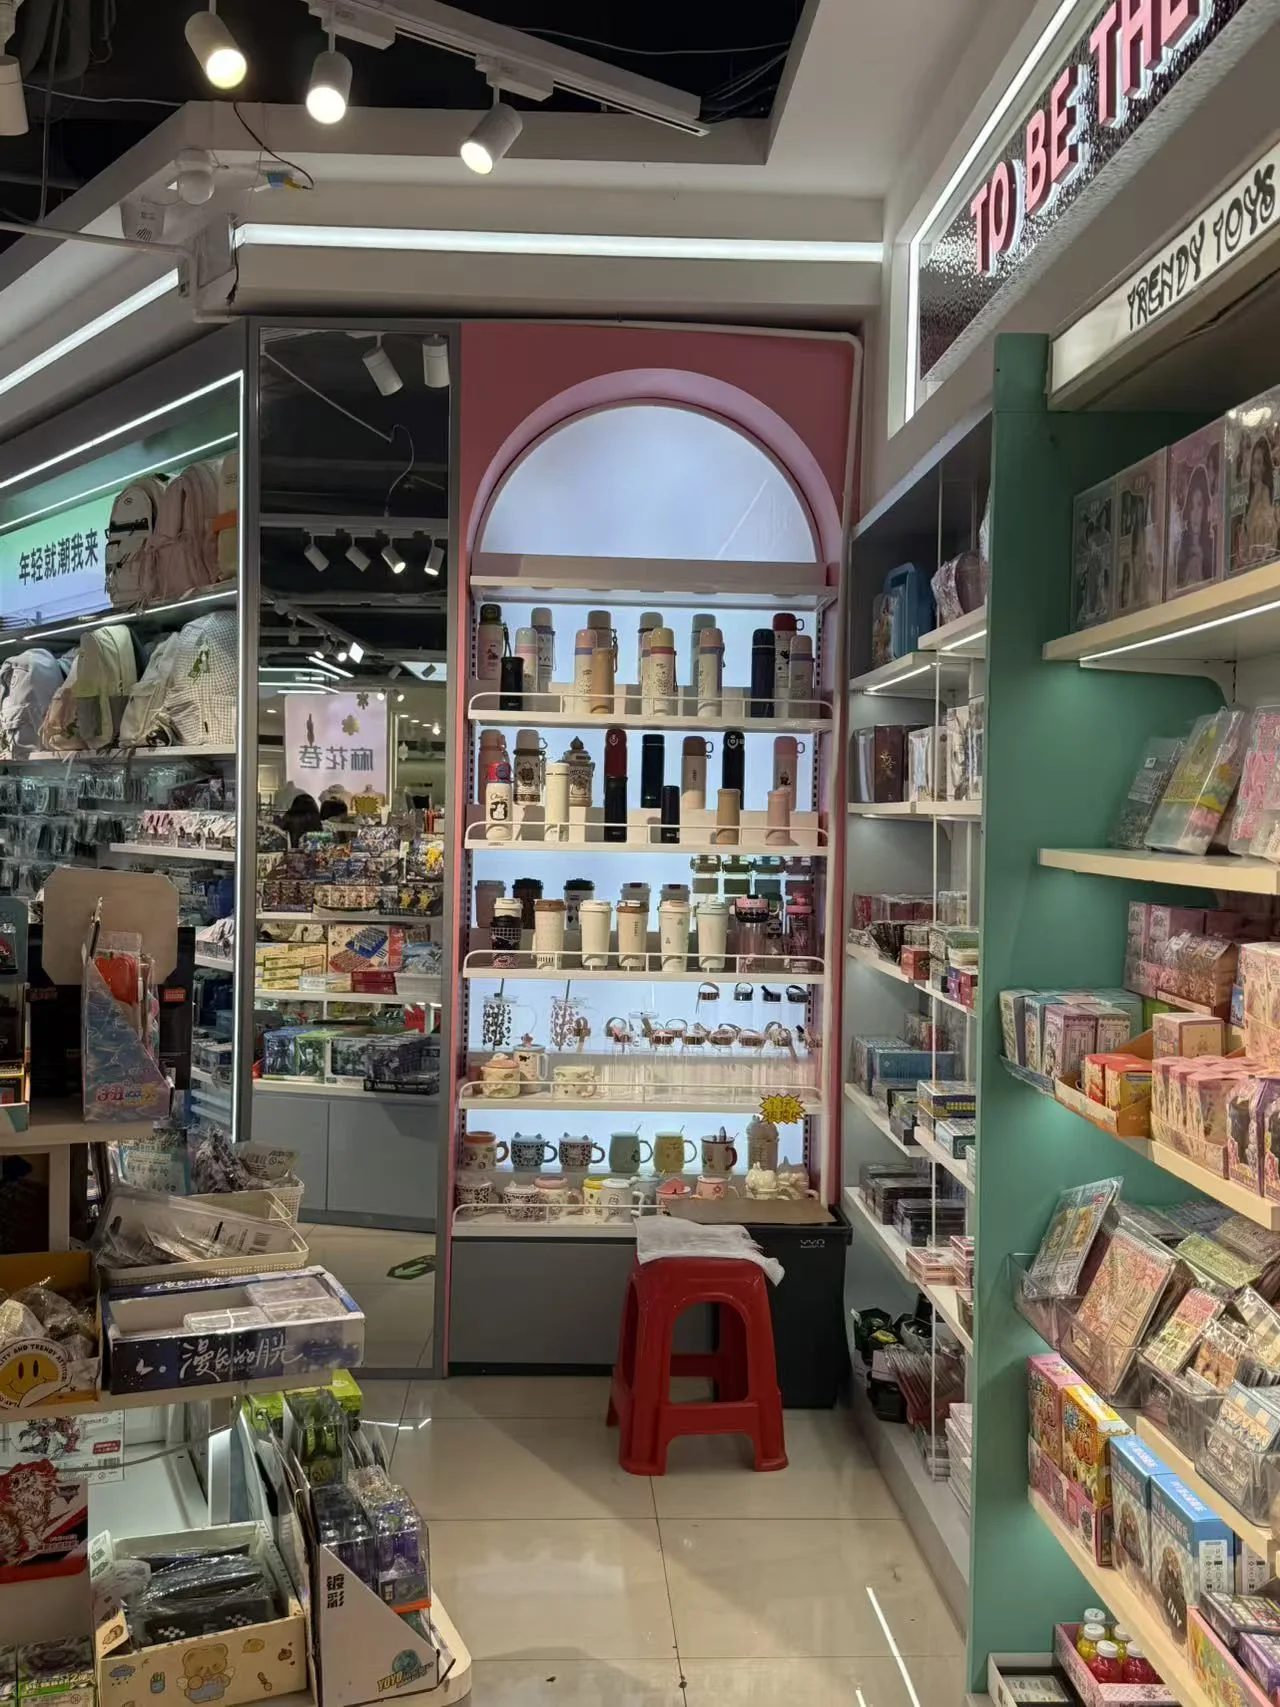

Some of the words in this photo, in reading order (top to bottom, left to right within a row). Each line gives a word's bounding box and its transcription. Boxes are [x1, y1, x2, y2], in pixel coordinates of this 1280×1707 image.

[970, 161, 1016, 276] TO
[1025, 65, 1077, 216] BE
[1127, 219, 1205, 331] TRENDY
[1213, 164, 1275, 263] TOYS
[19, 527, 98, 586] 年轻就潮我来
[30, 1343, 57, 1356] TRENDY
[179, 1335, 302, 1382] 漫长的月光
